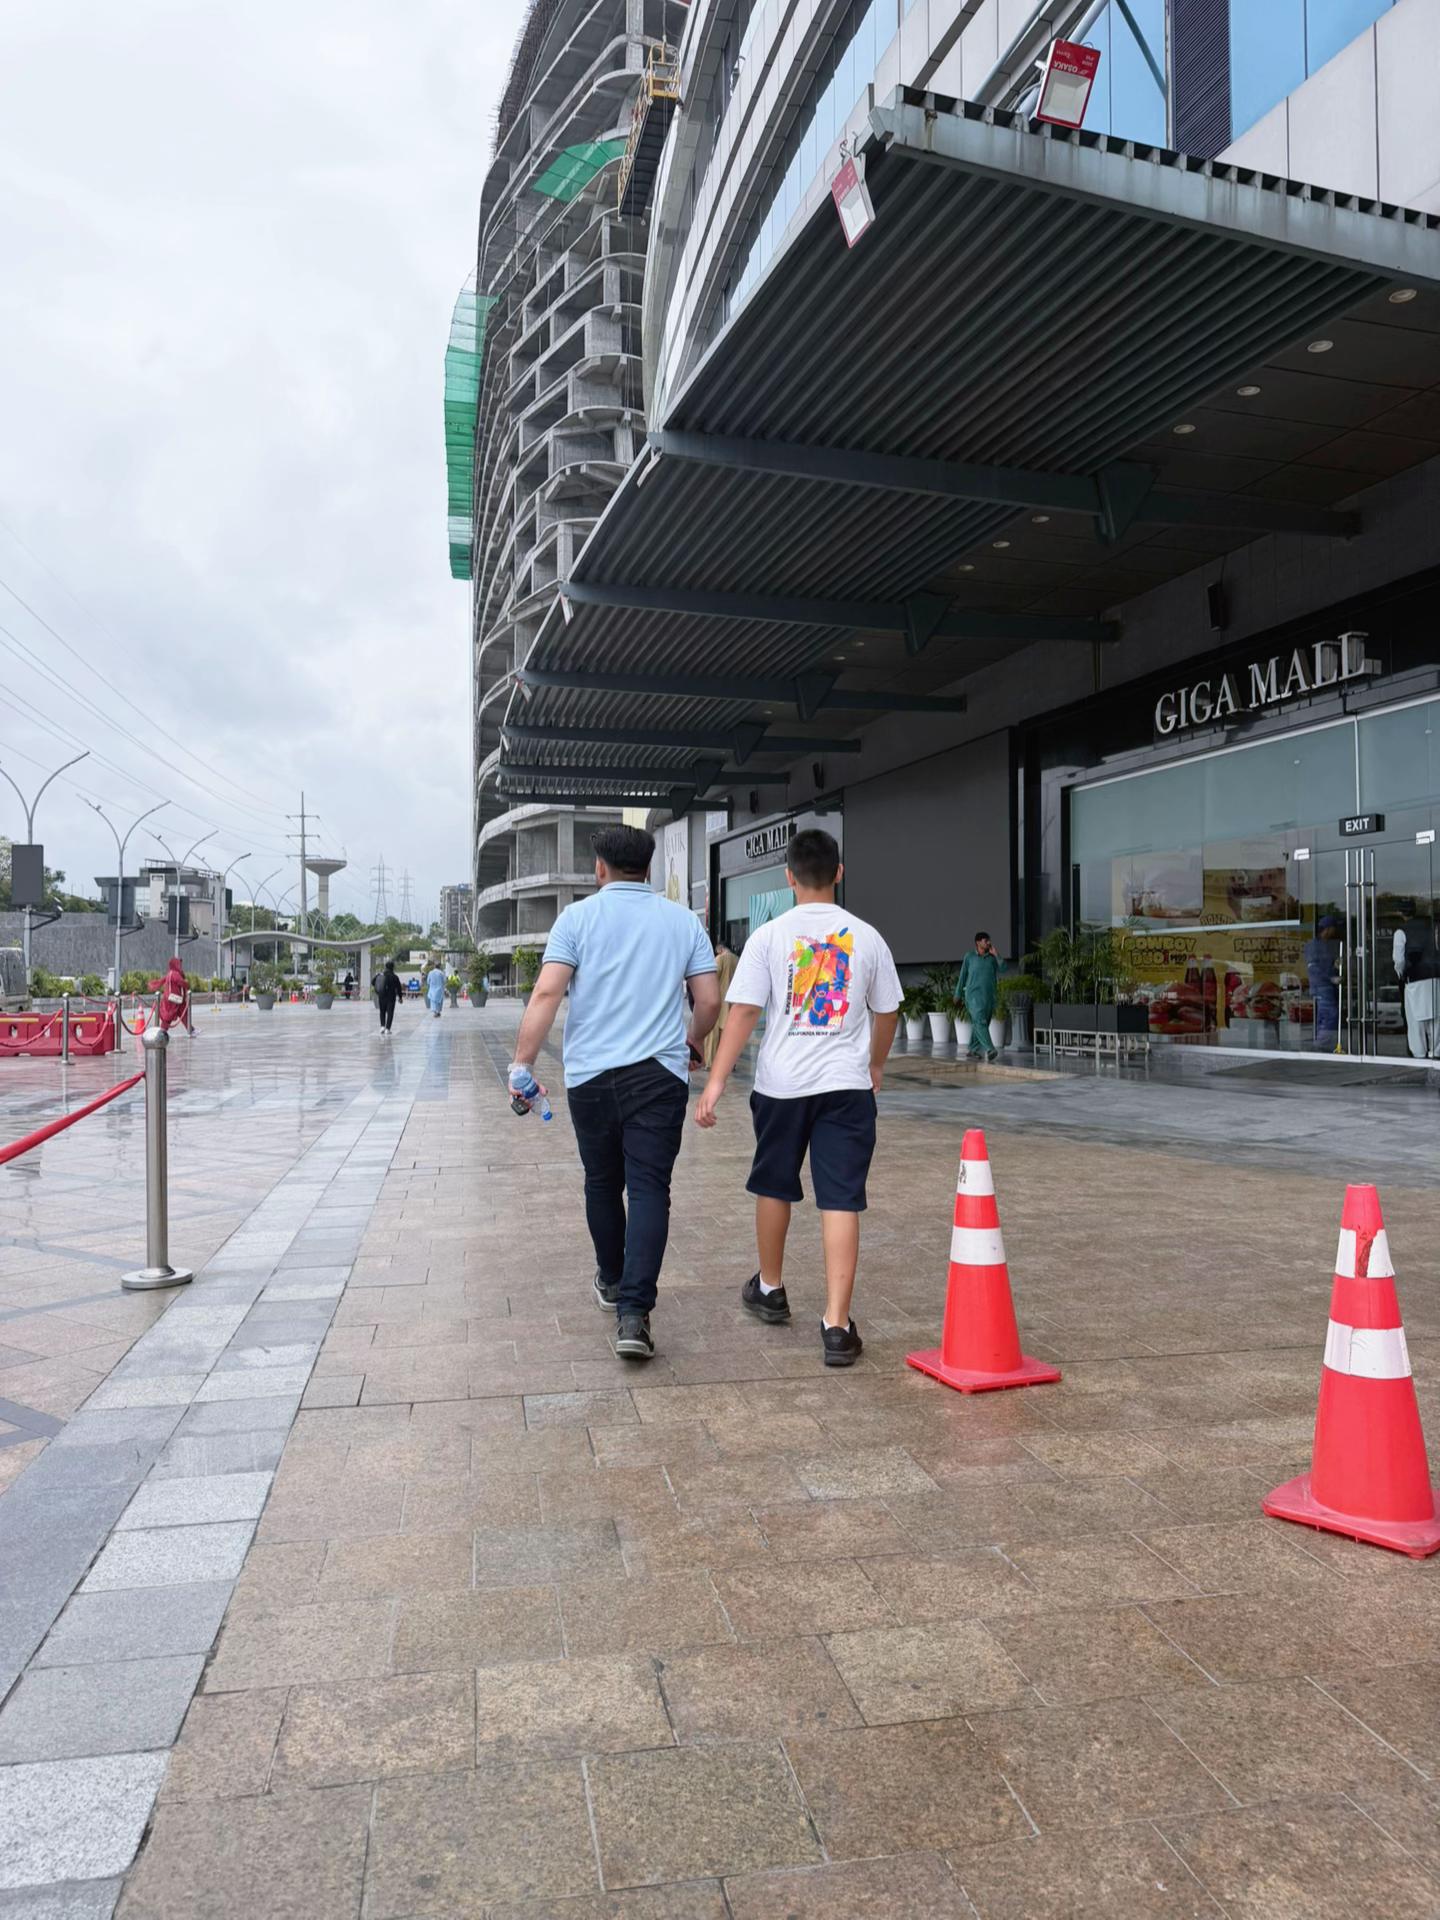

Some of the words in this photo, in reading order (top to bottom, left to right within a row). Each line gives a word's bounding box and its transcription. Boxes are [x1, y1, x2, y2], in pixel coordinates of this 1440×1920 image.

[1053, 60, 1079, 73] OSAKA
[1155, 673, 1237, 734] GIGA
[1248, 632, 1375, 708] MALL
[1345, 817, 1370, 832] EXIT
[744, 832, 765, 857] GIGA
[1124, 936, 1196, 951] COWBOY
